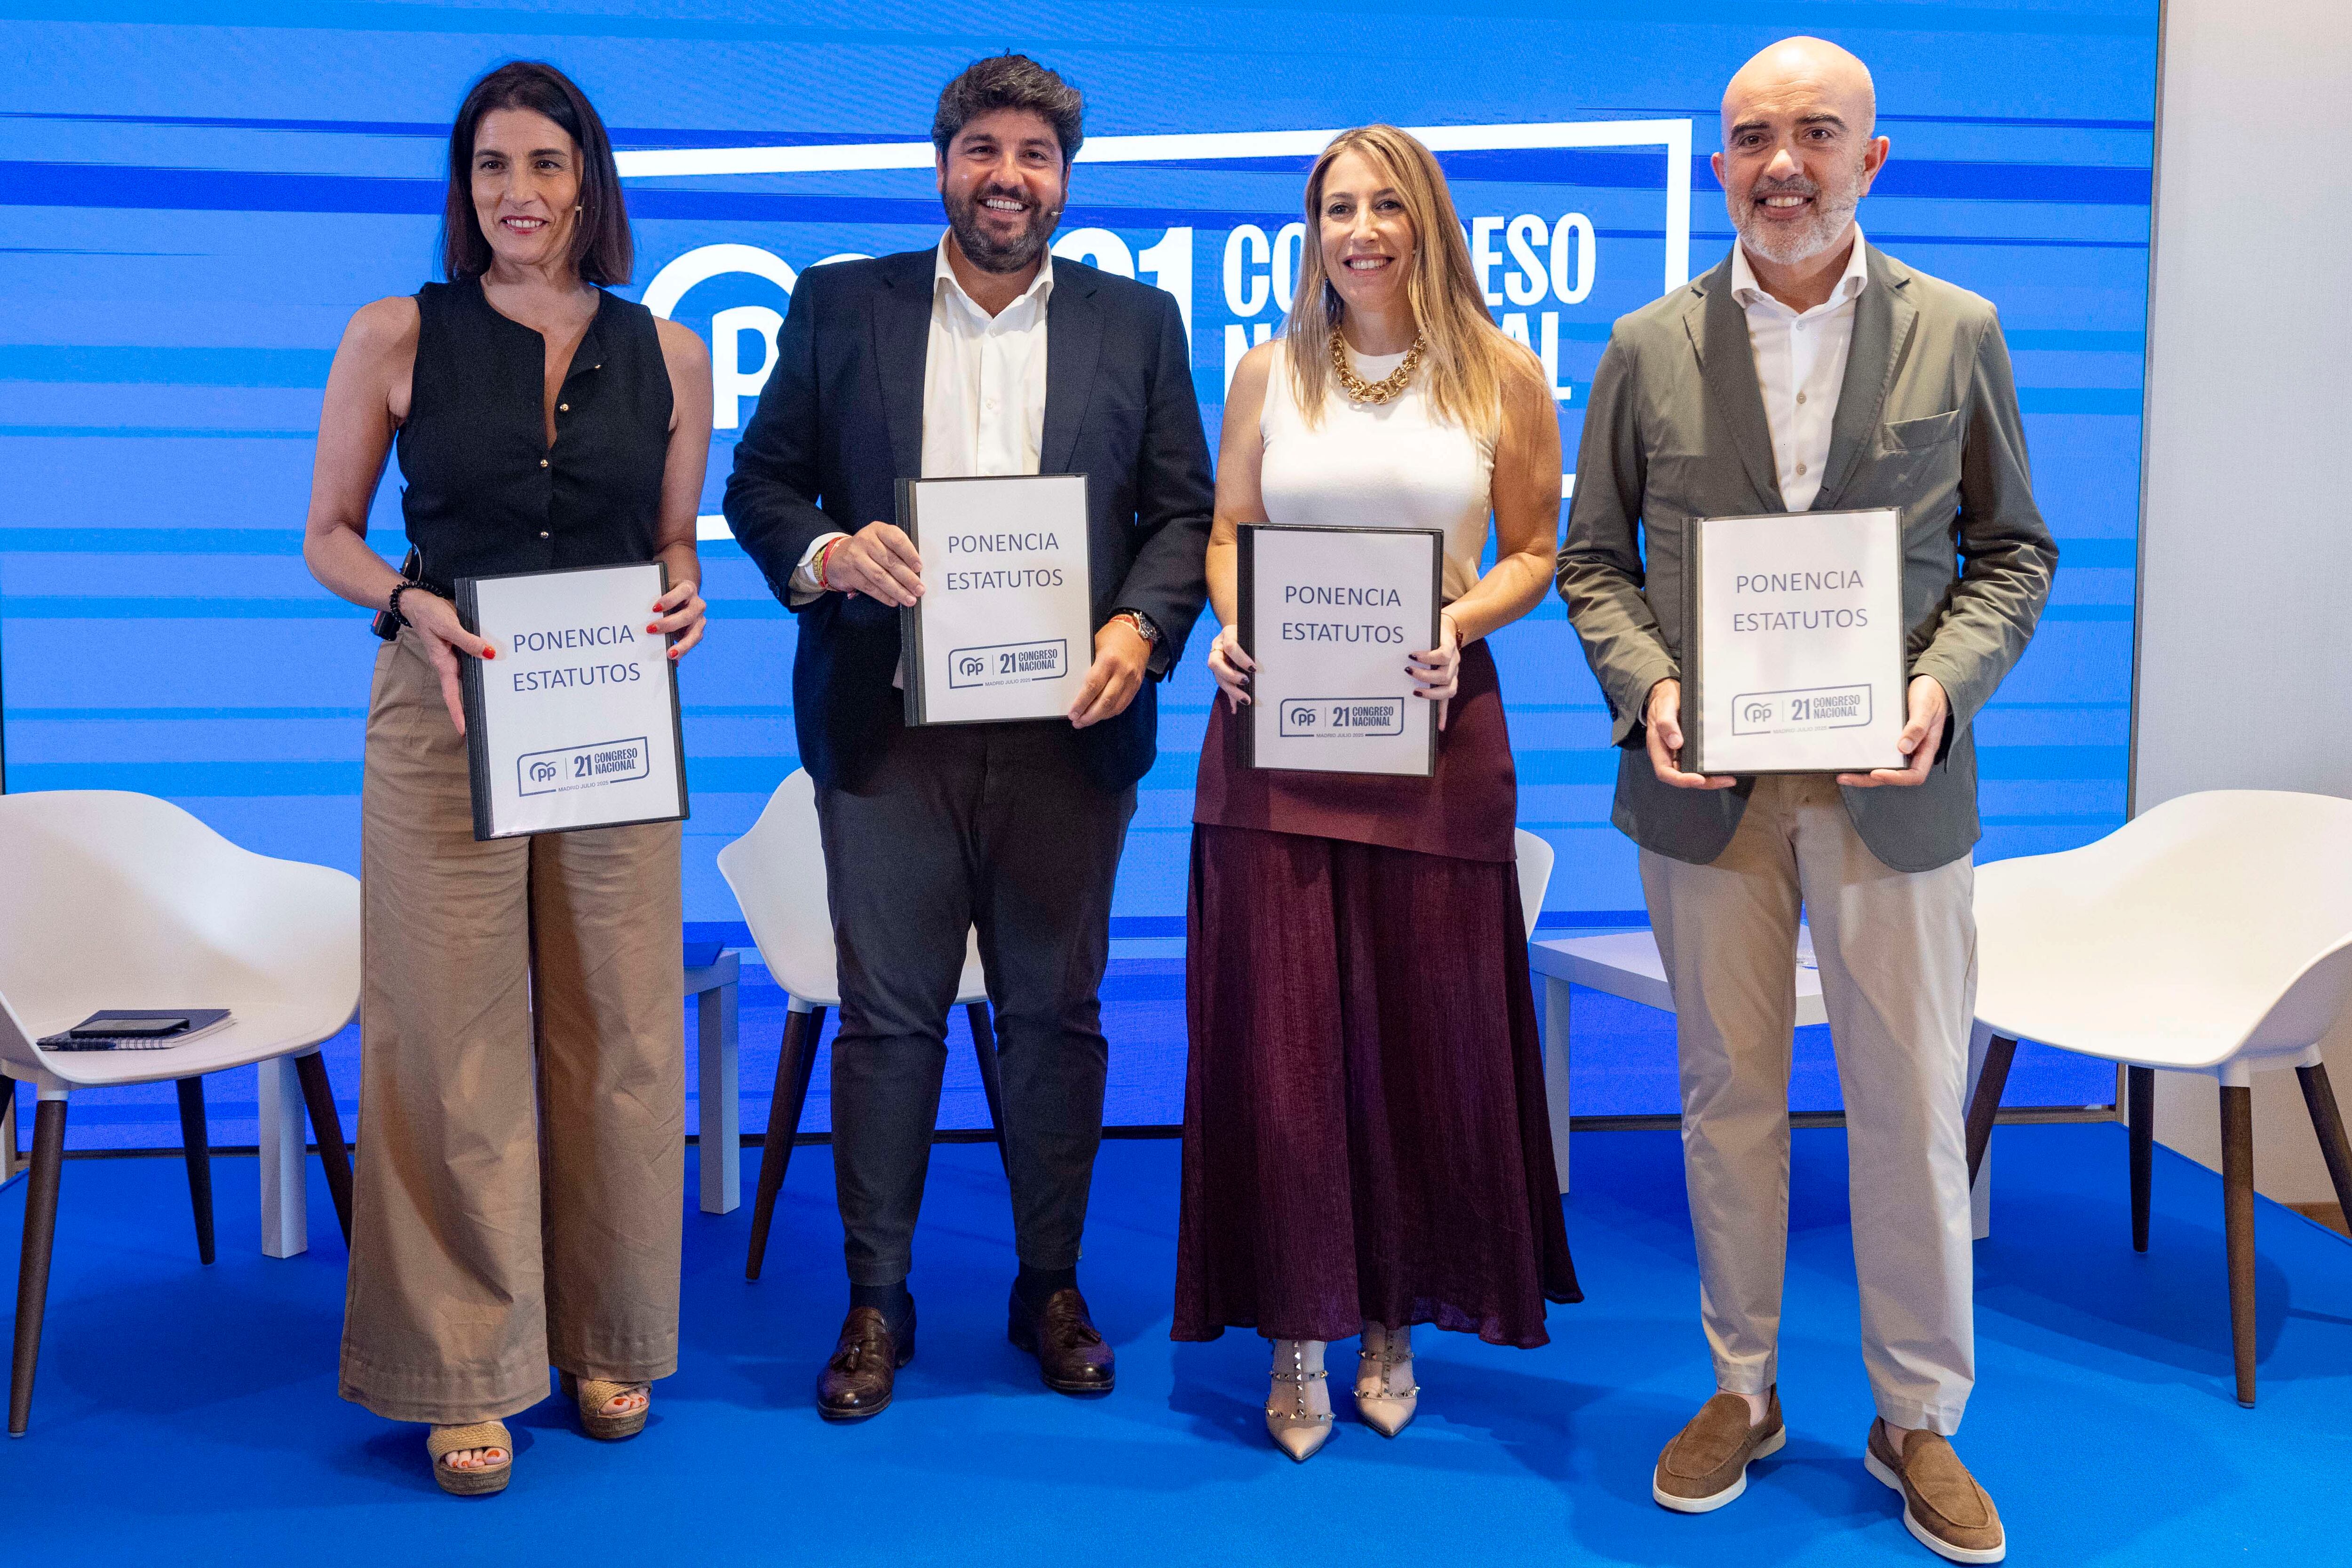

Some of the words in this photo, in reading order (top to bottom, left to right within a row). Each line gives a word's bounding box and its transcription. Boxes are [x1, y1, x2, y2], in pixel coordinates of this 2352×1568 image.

[948, 532, 1059, 554] PONENCIA
[947, 569, 1063, 590] ESTATUTOS
[1737, 570, 1864, 594] PONENCIA
[1285, 586, 1401, 607] PONENCIA
[1734, 609, 1868, 632] ESTATUTOS
[514, 625, 635, 653] PONENCIA
[1282, 623, 1404, 643] ESTATUTOS
[1000, 653, 1016, 674] 21
[1018, 649, 1057, 662] CONGRESO
[1019, 659, 1056, 672] NACIONAL
[514, 662, 640, 692] ESTATUTOS
[1333, 707, 1349, 727] 21
[1352, 706, 1393, 717] CONGRESO
[1792, 698, 1810, 721] 21
[1813, 695, 1860, 708] CONGRESO
[1814, 706, 1857, 719] NACIONAL
[1352, 717, 1391, 726] NACIONAL
[574, 754, 592, 778] 21
[595, 748, 637, 763] CONGRESO
[595, 760, 636, 775] NACIONAL
